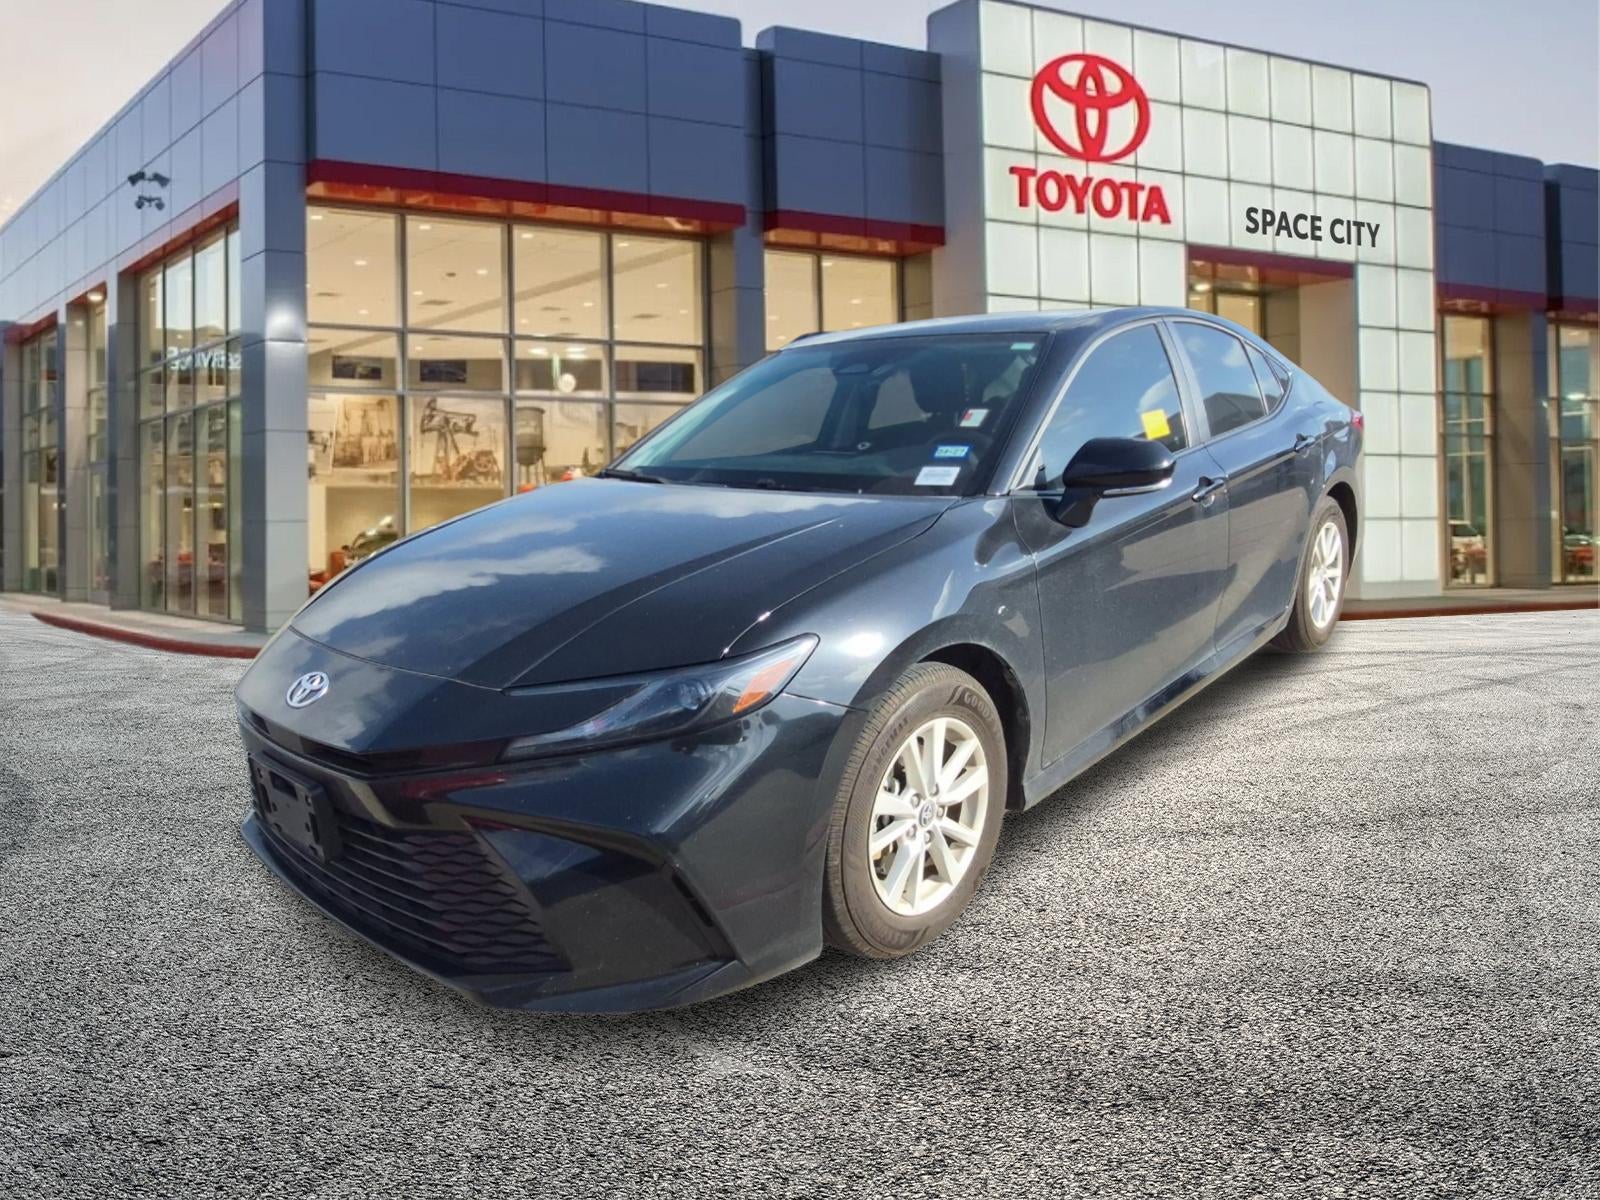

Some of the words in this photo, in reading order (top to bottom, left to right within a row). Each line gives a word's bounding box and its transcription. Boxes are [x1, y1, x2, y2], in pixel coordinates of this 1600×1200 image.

[1009, 166, 1171, 224] TOYOTA
[1245, 207, 1323, 241] SPACE
[1330, 219, 1381, 248] CITY
